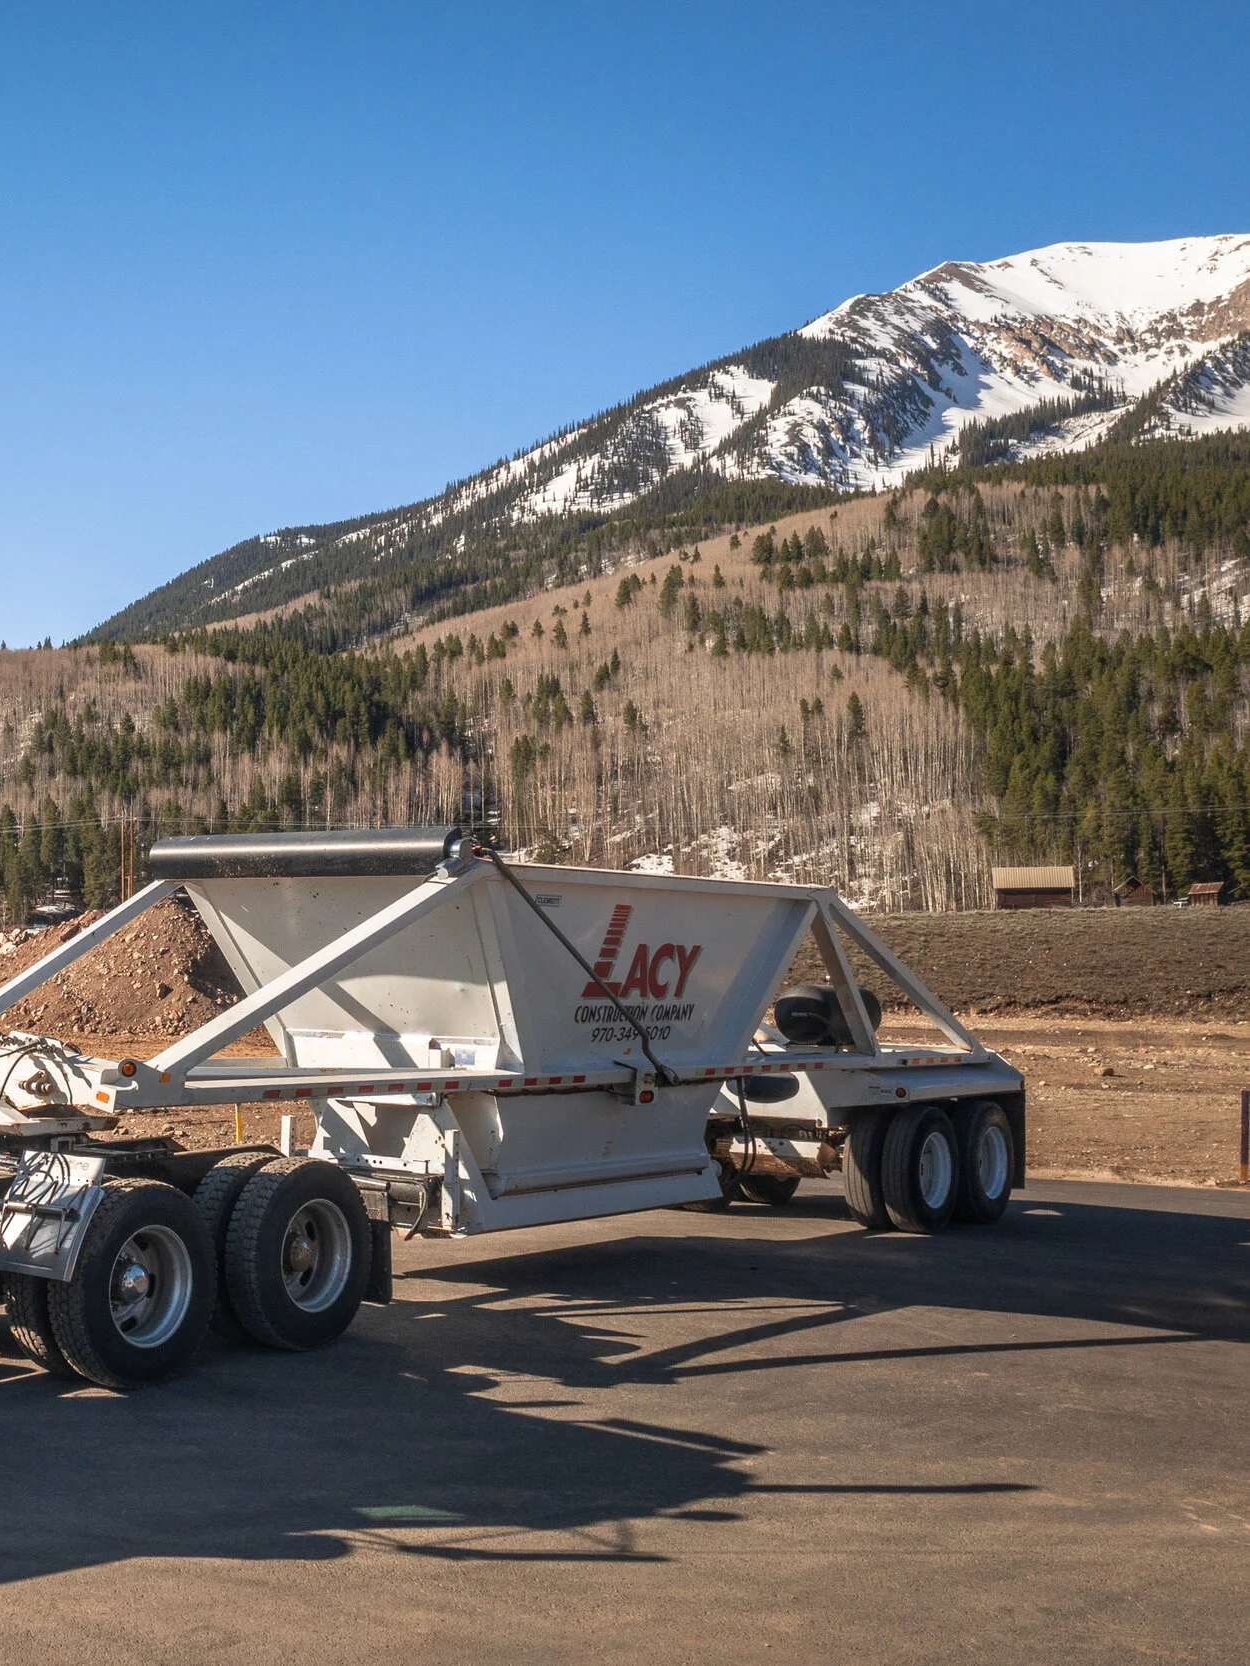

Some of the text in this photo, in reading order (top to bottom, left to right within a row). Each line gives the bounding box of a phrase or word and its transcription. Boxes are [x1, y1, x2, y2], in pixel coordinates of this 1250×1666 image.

[582, 904, 703, 999] LACY
[651, 1003, 695, 1021] COMPANY
[591, 1026, 671, 1042] 970-3495010
